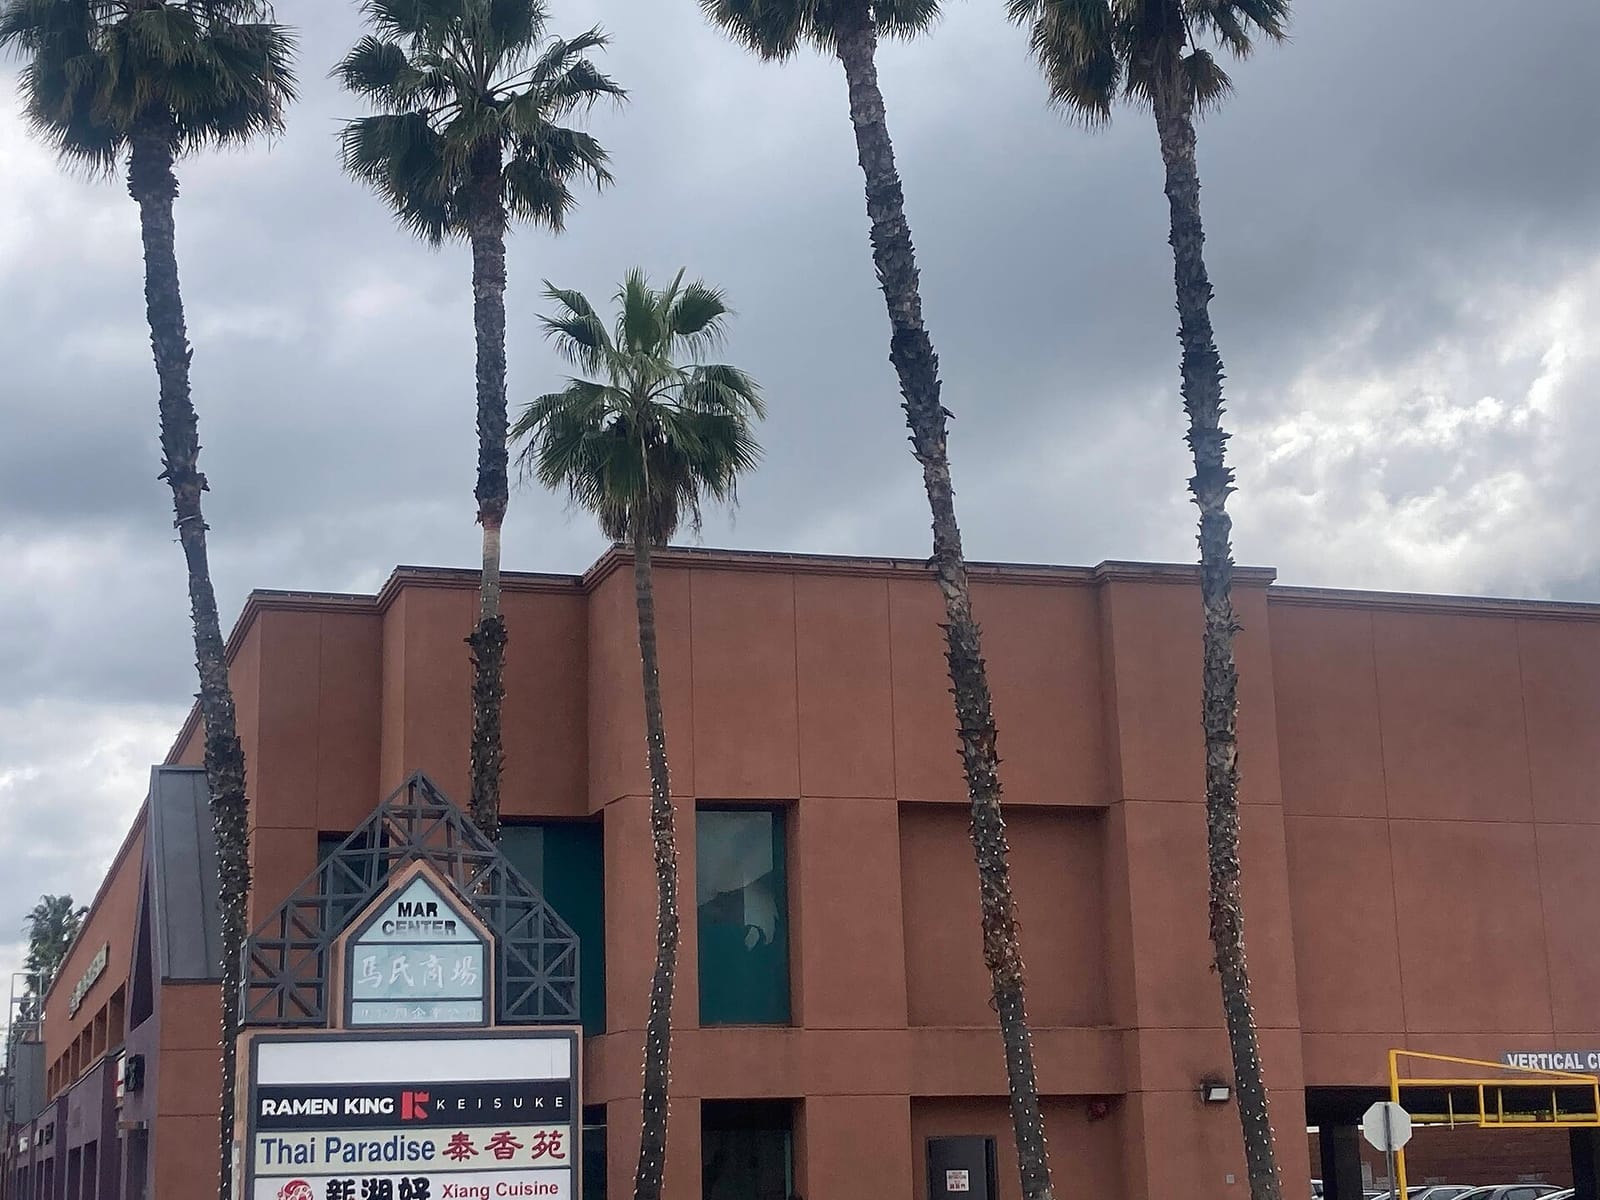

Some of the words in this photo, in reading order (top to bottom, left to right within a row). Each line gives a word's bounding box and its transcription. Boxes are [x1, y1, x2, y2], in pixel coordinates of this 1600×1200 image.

[398, 902, 438, 917] MAR
[382, 920, 456, 936] CENTER
[358, 954, 478, 988] 馬氏商場
[1507, 1053, 1584, 1070] VERTICAL
[261, 1098, 338, 1116] RAMEN
[344, 1098, 394, 1114] KING
[436, 1097, 564, 1110] KEISUKE
[260, 1137, 315, 1165] Thai
[325, 1134, 436, 1163] Paradise
[442, 1130, 566, 1163] 泰香苑
[442, 1183, 490, 1200] Xiang
[496, 1181, 559, 1196] Cuisine
